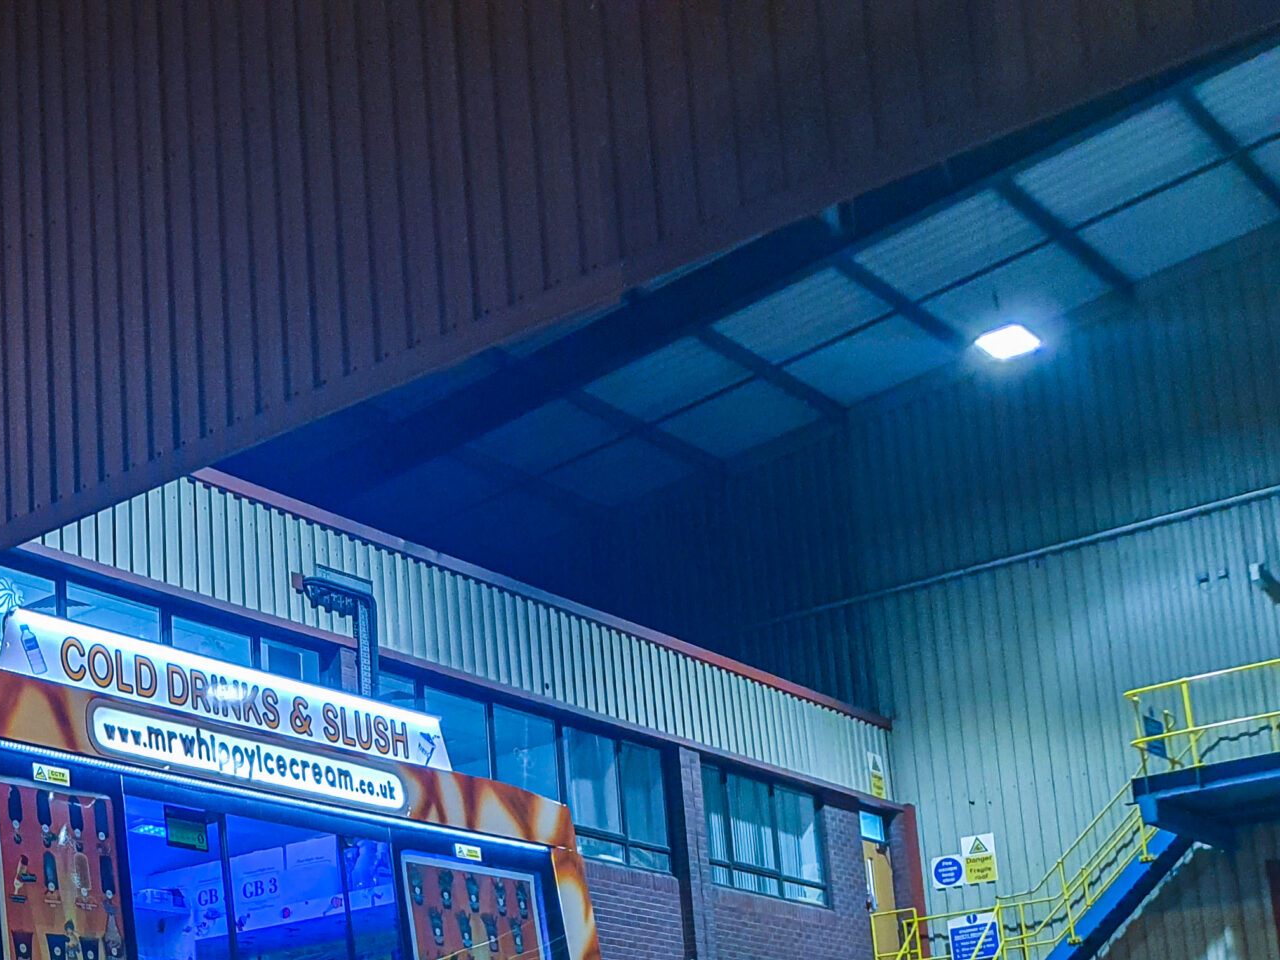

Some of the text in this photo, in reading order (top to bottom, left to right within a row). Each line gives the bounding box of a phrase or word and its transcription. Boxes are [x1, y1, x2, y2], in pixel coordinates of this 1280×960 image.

[61, 636, 409, 759] COLD DRINKS & SLUSH
[242, 877, 278, 898] GB 3
